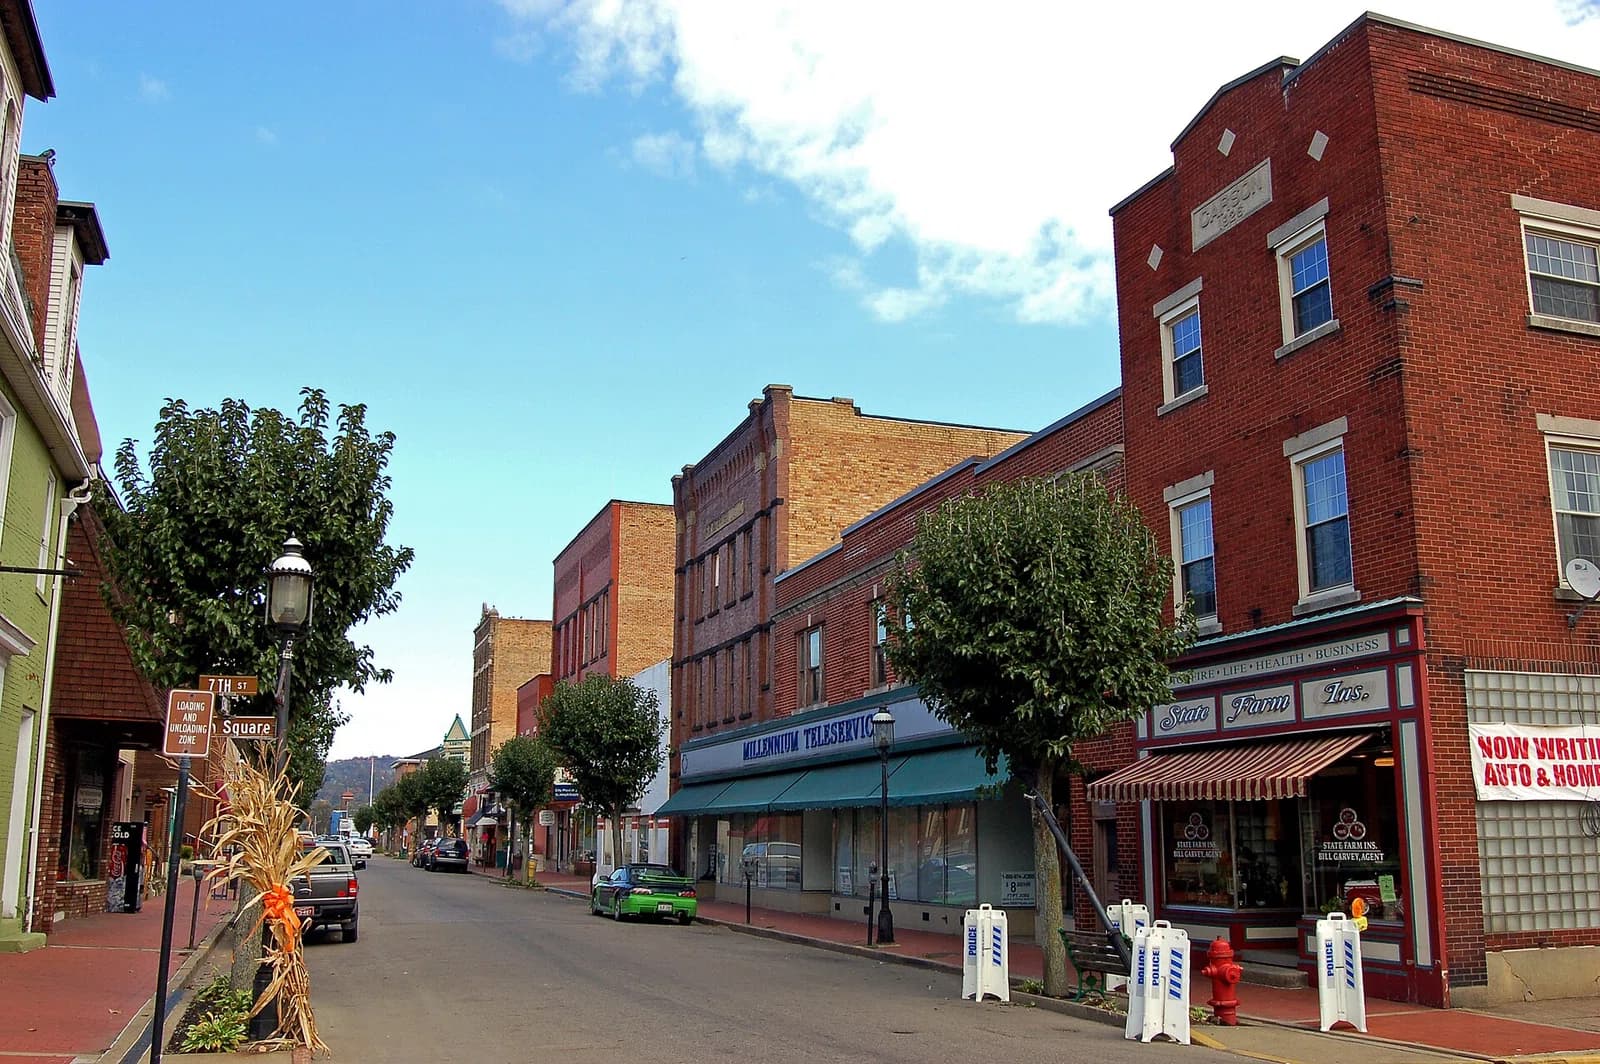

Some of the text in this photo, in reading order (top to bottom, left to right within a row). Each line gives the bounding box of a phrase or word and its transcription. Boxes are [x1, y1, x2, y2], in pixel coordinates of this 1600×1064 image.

[1199, 178, 1263, 229] CARSON
[1223, 663, 1247, 677] LIFE
[1256, 652, 1304, 672] HEALTH
[1315, 638, 1379, 660] BUSINESS
[208, 678, 247, 692] 7TH ST
[176, 701, 205, 711] LOADING
[182, 713, 197, 722] AND
[1160, 680, 1370, 730] State Farm Ins.
[169, 723, 208, 734] UNLOADING
[178, 735, 196, 745] ZONE
[222, 719, 271, 737] Square
[742, 713, 874, 761] MILLENNIUM TELESERVIC
[1477, 735, 1529, 760] NOW
[1484, 762, 1532, 787] AUTO
[1536, 767, 1551, 787] &
[1318, 853, 1333, 861] BILL
[1361, 853, 1384, 861] AGENT
[1322, 841, 1378, 850] STATE FARM INS.
[968, 927, 977, 956] POLICE
[1152, 950, 1160, 987] POLICE
[1325, 940, 1334, 977] POLICE
